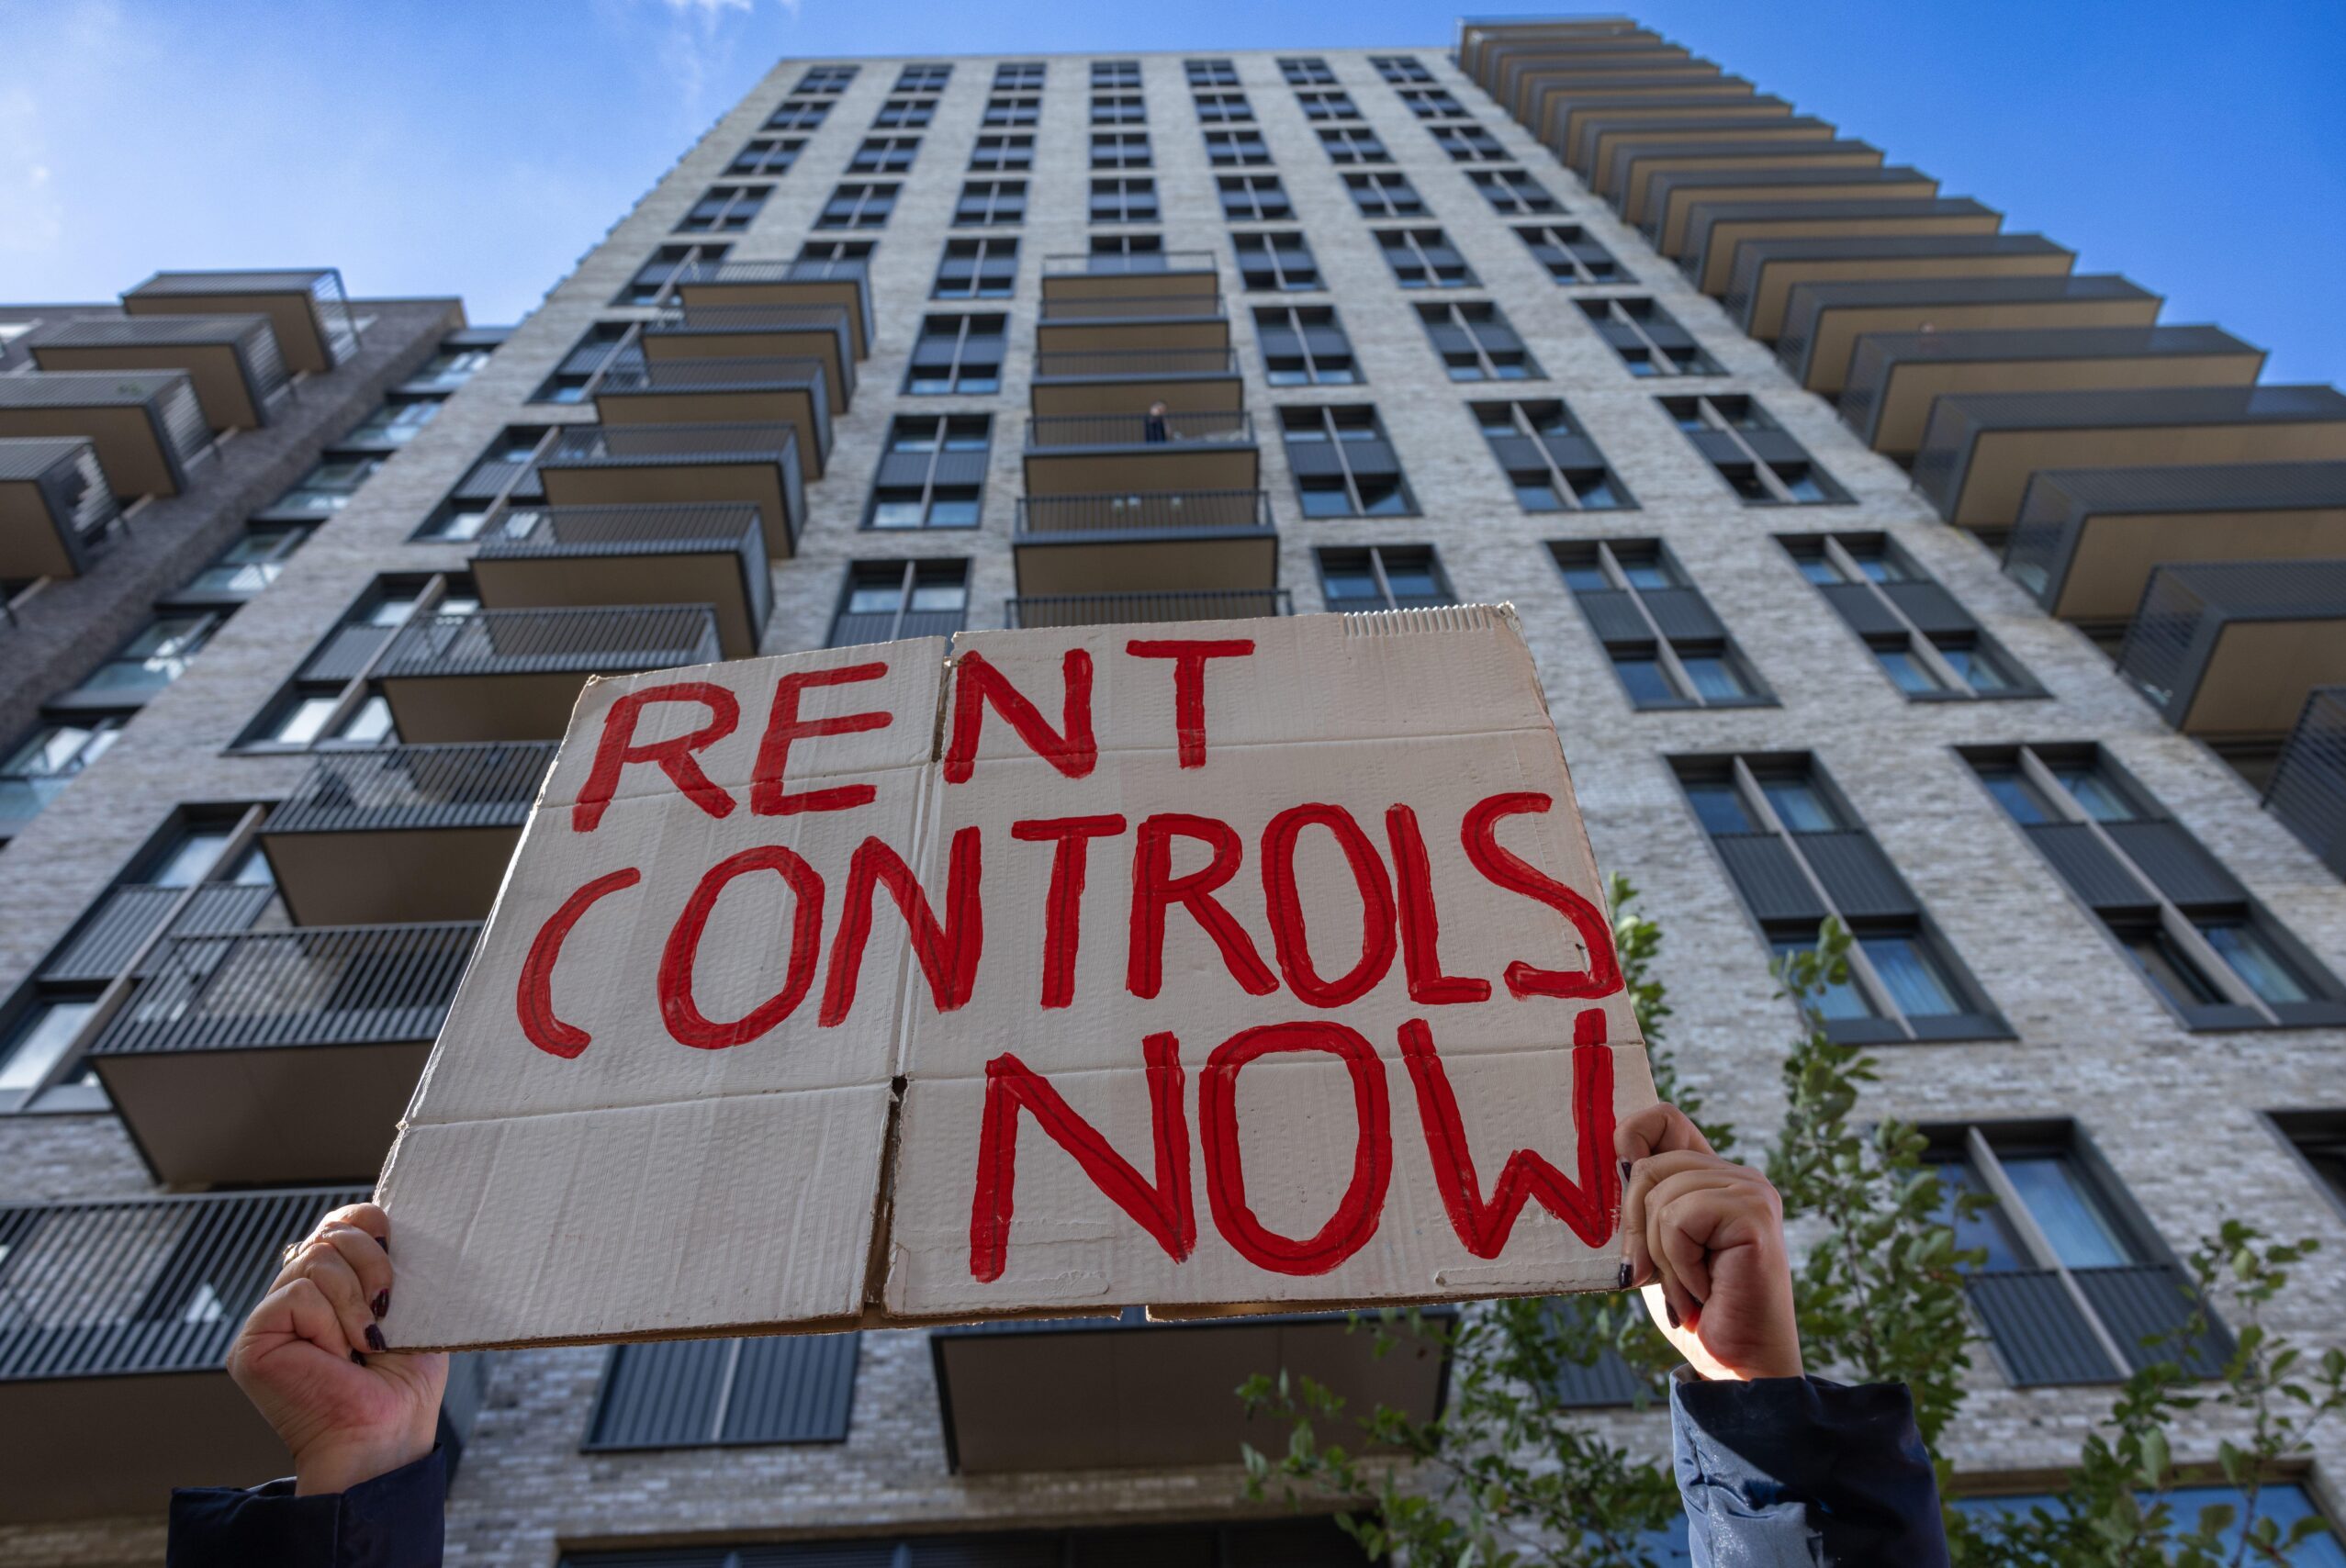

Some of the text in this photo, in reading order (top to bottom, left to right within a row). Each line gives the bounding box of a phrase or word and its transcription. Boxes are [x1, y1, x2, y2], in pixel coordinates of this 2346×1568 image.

[572, 638, 1256, 833] RENT
[516, 790, 1626, 1059] CONTROLS
[969, 1007, 1623, 1284] NOW
